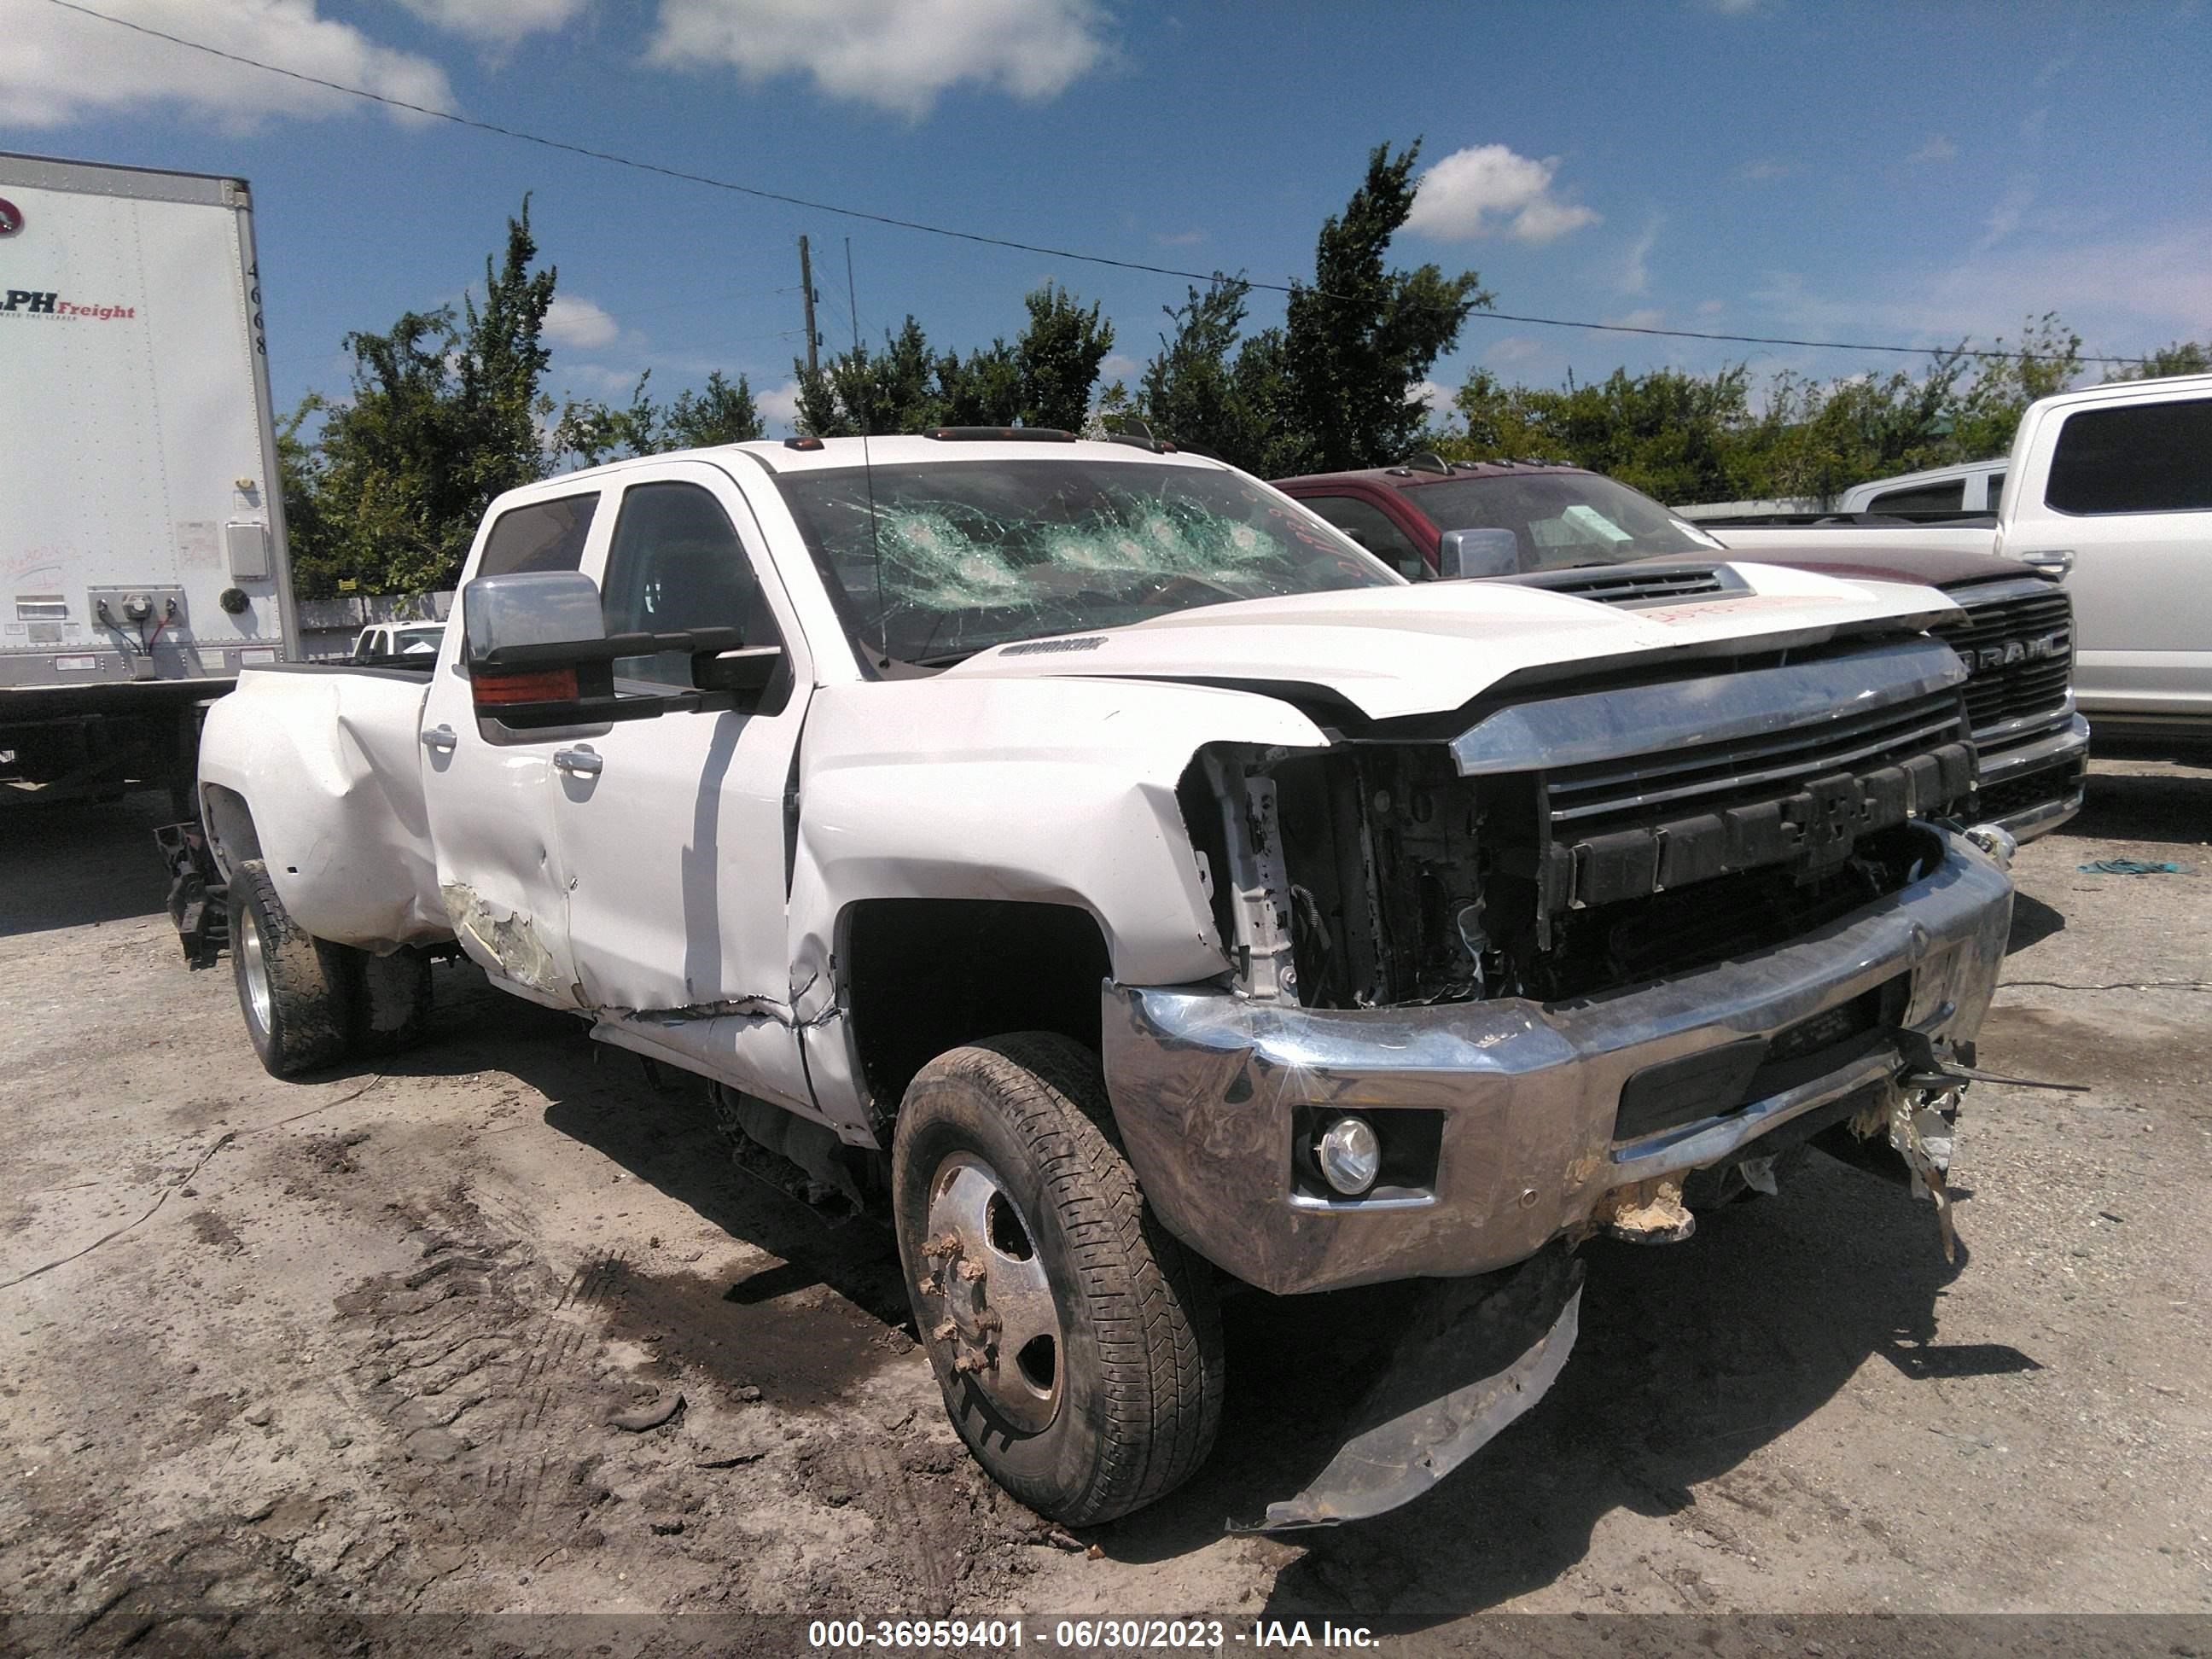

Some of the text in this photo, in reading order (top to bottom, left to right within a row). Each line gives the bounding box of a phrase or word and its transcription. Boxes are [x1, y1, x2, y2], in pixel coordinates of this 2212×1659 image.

[0, 290, 135, 320] PH Freight
[247, 260, 267, 356] 4668
